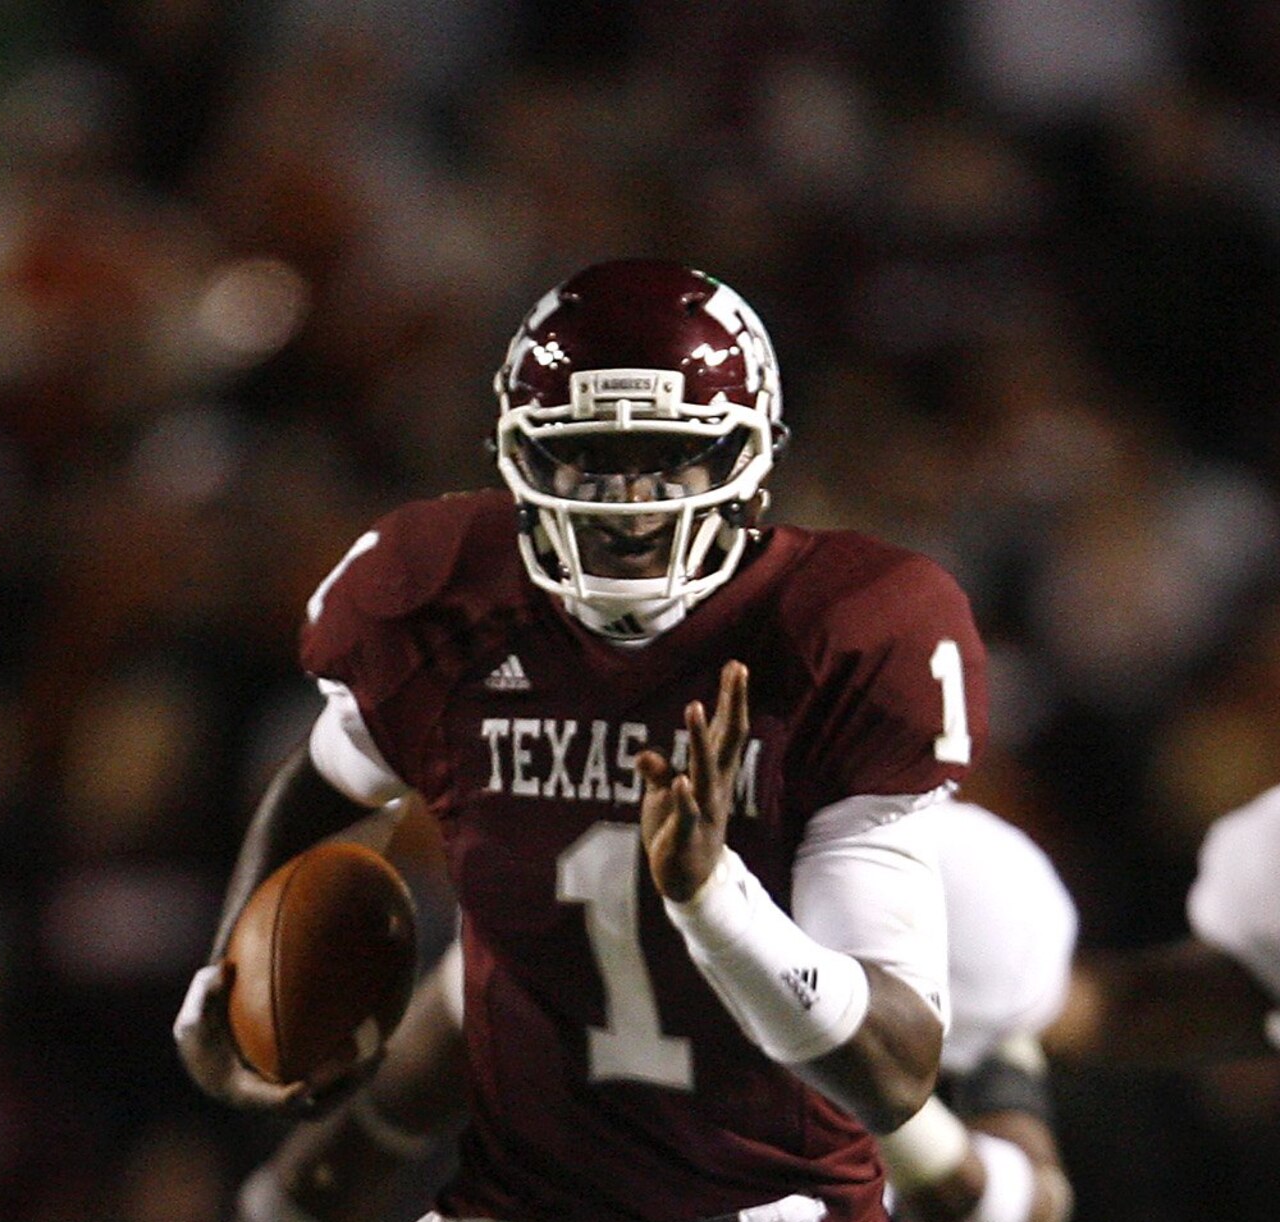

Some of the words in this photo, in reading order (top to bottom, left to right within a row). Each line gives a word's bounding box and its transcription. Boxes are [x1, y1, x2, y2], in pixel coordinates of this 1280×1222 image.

[481, 718, 648, 804] TEXAS
[930, 640, 971, 764] 1
[556, 820, 695, 1091] 1
